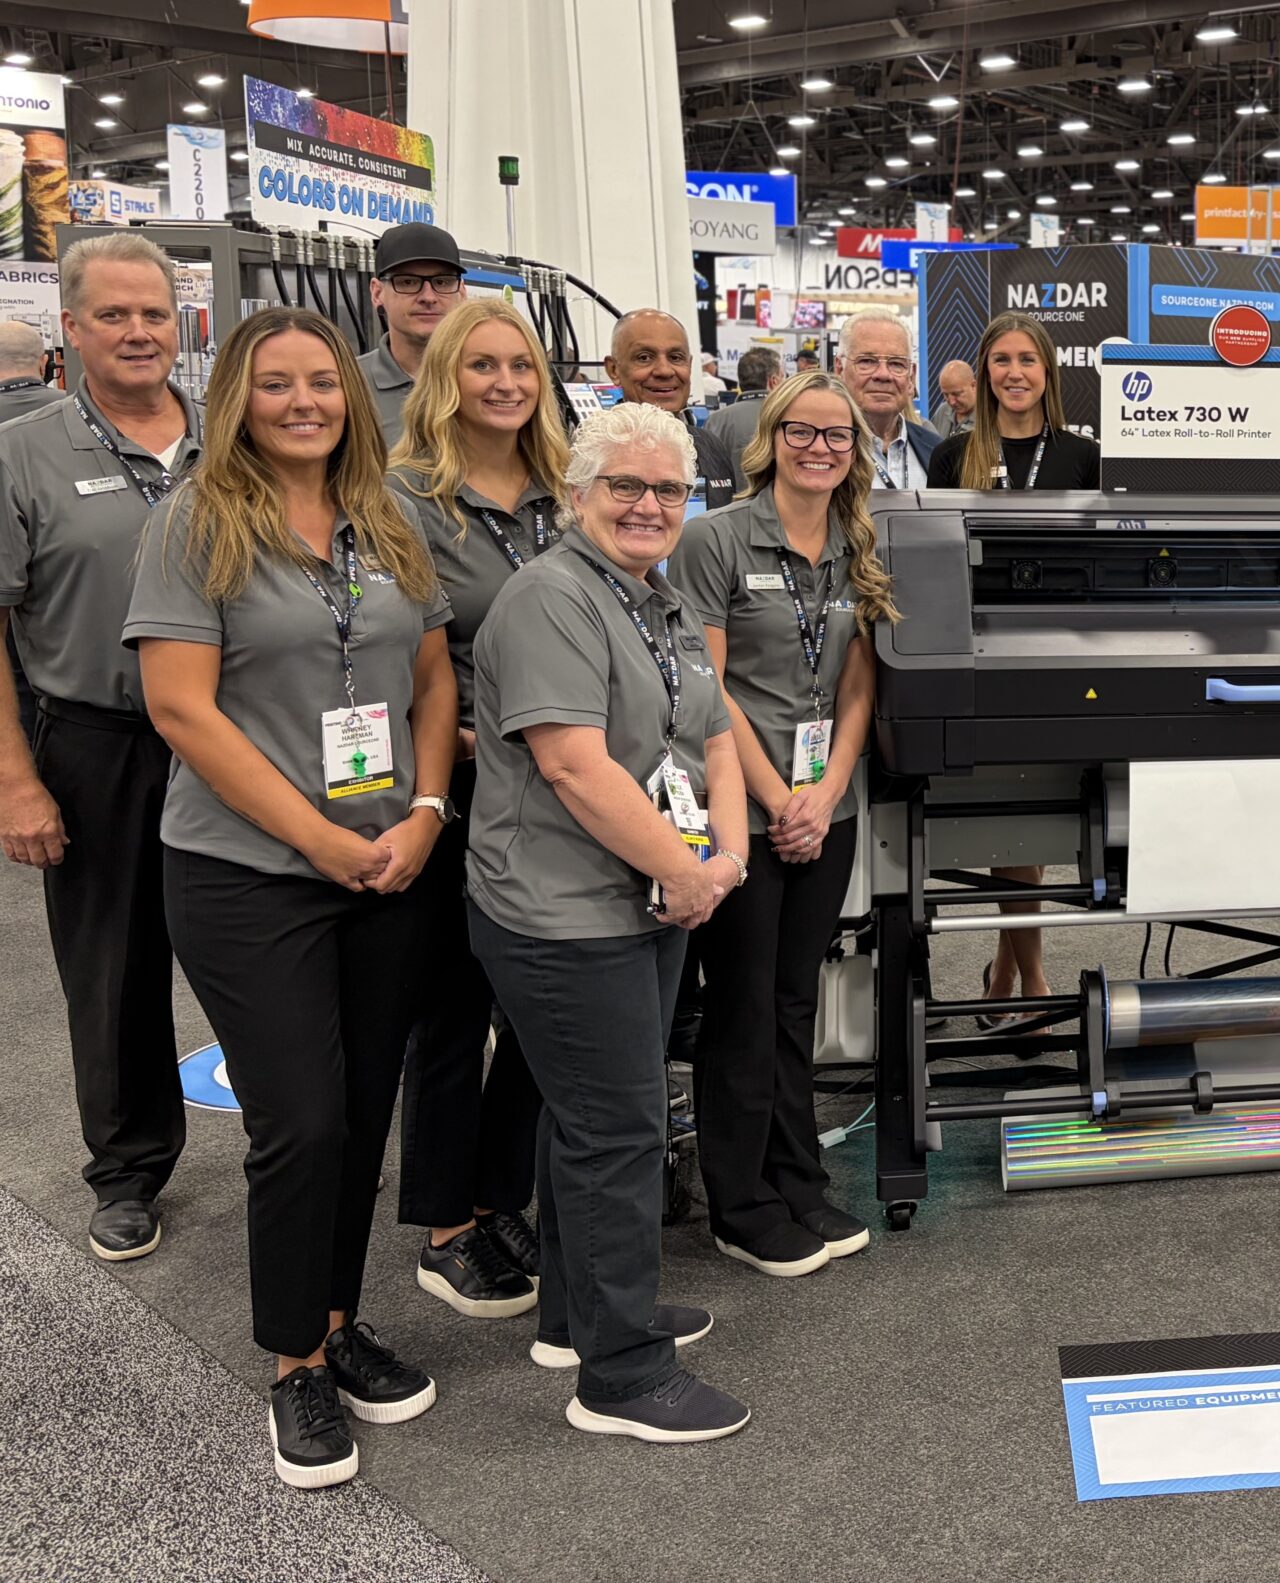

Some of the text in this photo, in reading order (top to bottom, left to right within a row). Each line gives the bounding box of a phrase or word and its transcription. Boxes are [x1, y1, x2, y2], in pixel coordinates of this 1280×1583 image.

[287, 137, 407, 180] MIX ACCURATE, CONSISTENT
[259, 165, 434, 226] COLORS ON DEMAND
[1008, 282, 1108, 308] NAZDAR
[1217, 328, 1267, 337] INTRODUCING
[1125, 371, 1150, 402] hp
[1121, 405, 1249, 423] Latex 730 W
[1142, 428, 1171, 438] Latex
[1174, 428, 1234, 438] Roll-to-Roll
[1237, 429, 1272, 439] Printer
[604, 573, 629, 604] NAZDAR
[632, 610, 654, 644] NAZDAR
[1092, 1398, 1188, 1413] FEATURED
